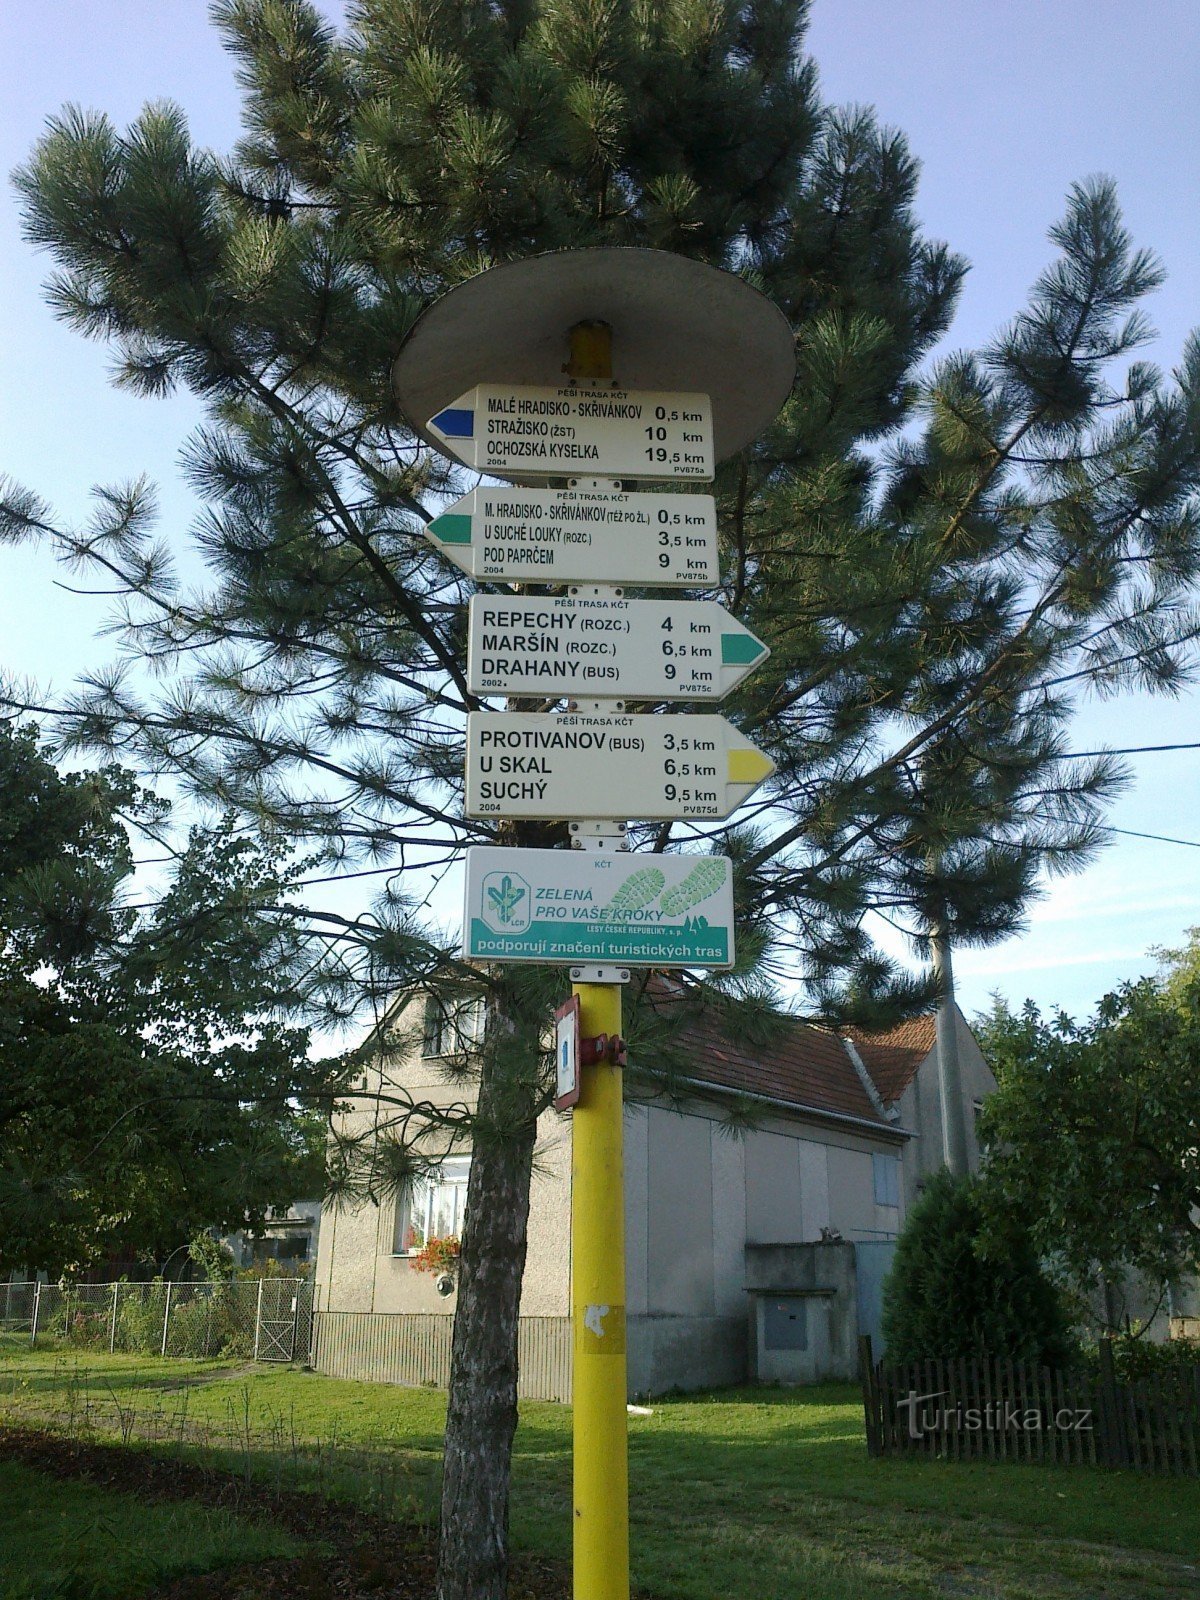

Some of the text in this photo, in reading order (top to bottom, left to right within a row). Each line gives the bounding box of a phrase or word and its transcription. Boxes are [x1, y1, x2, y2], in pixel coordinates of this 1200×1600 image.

[580, 390, 608, 398] TRASA
[611, 391, 628, 399] KČT
[488, 396, 515, 413] MALÉ
[519, 400, 570, 416] HRADISKO
[578, 400, 642, 419] SKŘIVÁNKOV
[655, 406, 702, 422] 0,5 km
[488, 418, 575, 439] STRAŽISKO (ŽST)
[645, 427, 703, 442] 10 km
[487, 440, 599, 459] OCHOZSKÁ KYSELKA
[645, 448, 704, 464] 19,5 km
[611, 494, 629, 502] KČT
[485, 503, 495, 517] M.
[497, 504, 542, 519] HRADISKO
[549, 503, 606, 522] SKŘIVÁNKOV
[625, 513, 635, 522] PO
[658, 510, 705, 525] 0,5 km
[485, 525, 491, 539] U
[494, 523, 527, 541] SUCHÉ
[529, 527, 562, 542] LOUKY
[659, 531, 706, 547] 3,5 km
[484, 546, 554, 564] POD PAPRČEM
[659, 553, 707, 569] 9 km
[610, 600, 629, 609] KČT
[483, 611, 630, 633] REPECHY (ROZC.)
[661, 617, 711, 634] 4 km
[482, 633, 617, 657] MARŠÍN (ROZC.)
[662, 640, 712, 658] 6,5 km
[482, 659, 620, 680] DRAHANY (BUS)
[665, 664, 712, 681] 9 km
[679, 685, 712, 693] PV875c
[557, 717, 634, 727] PĚŠÍ TRASA KČT
[480, 731, 645, 752] PROTIVANOV (BUS)
[663, 734, 715, 753] 3,5 km
[480, 756, 552, 774] U SKAL
[664, 758, 716, 778] 6,5 km
[480, 779, 548, 799] SUCHÝ
[664, 784, 716, 803] 9,5 km
[479, 803, 501, 812] 2004
[683, 805, 718, 814] PV875d
[594, 860, 612, 869] KČT
[535, 887, 593, 901] ZELENÁ
[535, 905, 664, 921] PRO VAŠE KROKY
[605, 924, 626, 933] ČESKÉ
[477, 938, 722, 958] podporují značení turistických tras
